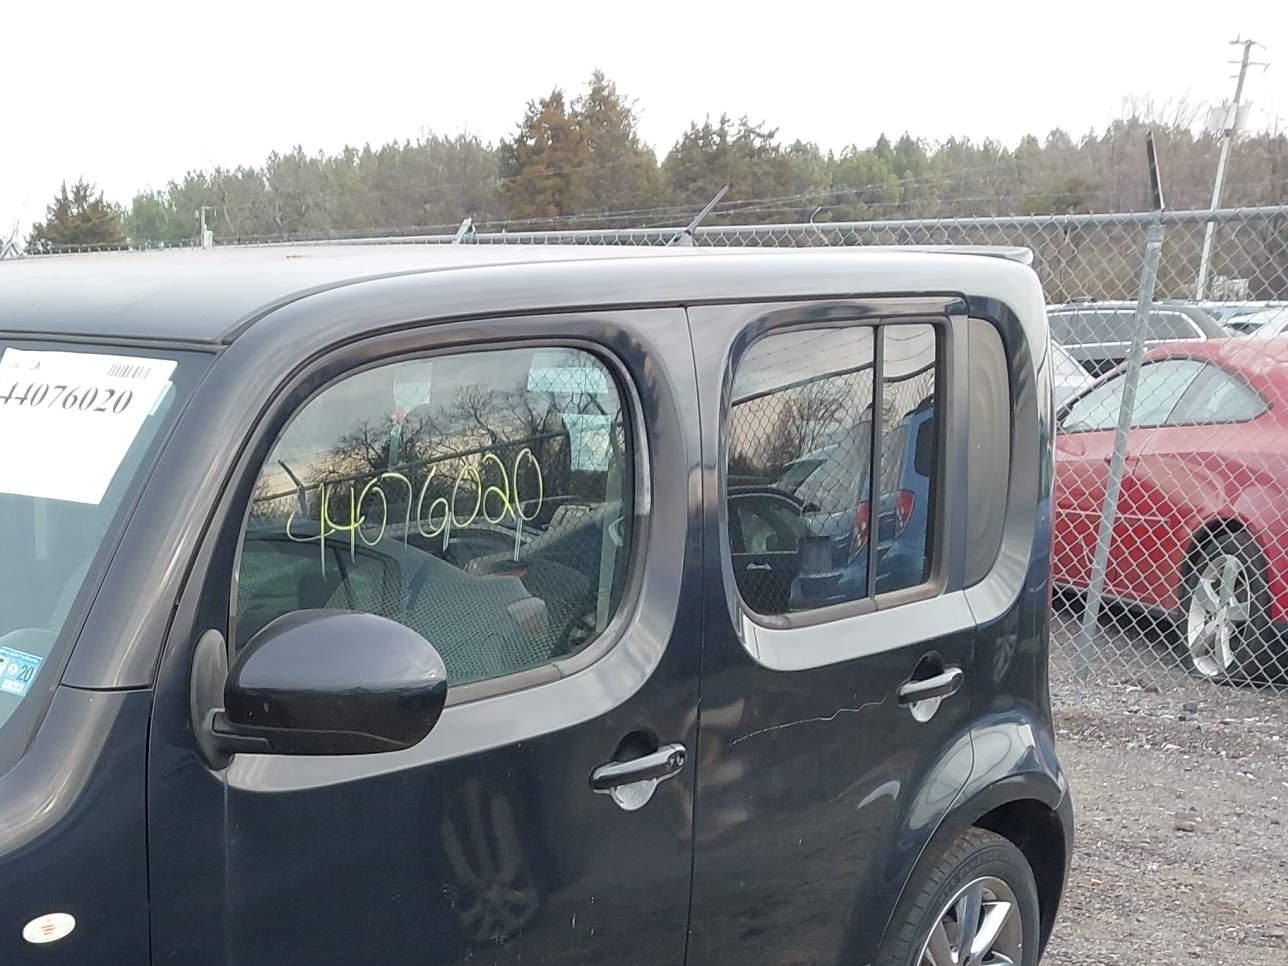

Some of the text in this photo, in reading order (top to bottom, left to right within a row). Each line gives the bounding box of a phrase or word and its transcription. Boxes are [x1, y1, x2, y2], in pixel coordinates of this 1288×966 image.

[0, 380, 134, 415] 44076020
[286, 447, 544, 576] 44076020
[16, 663, 35, 683] 20
